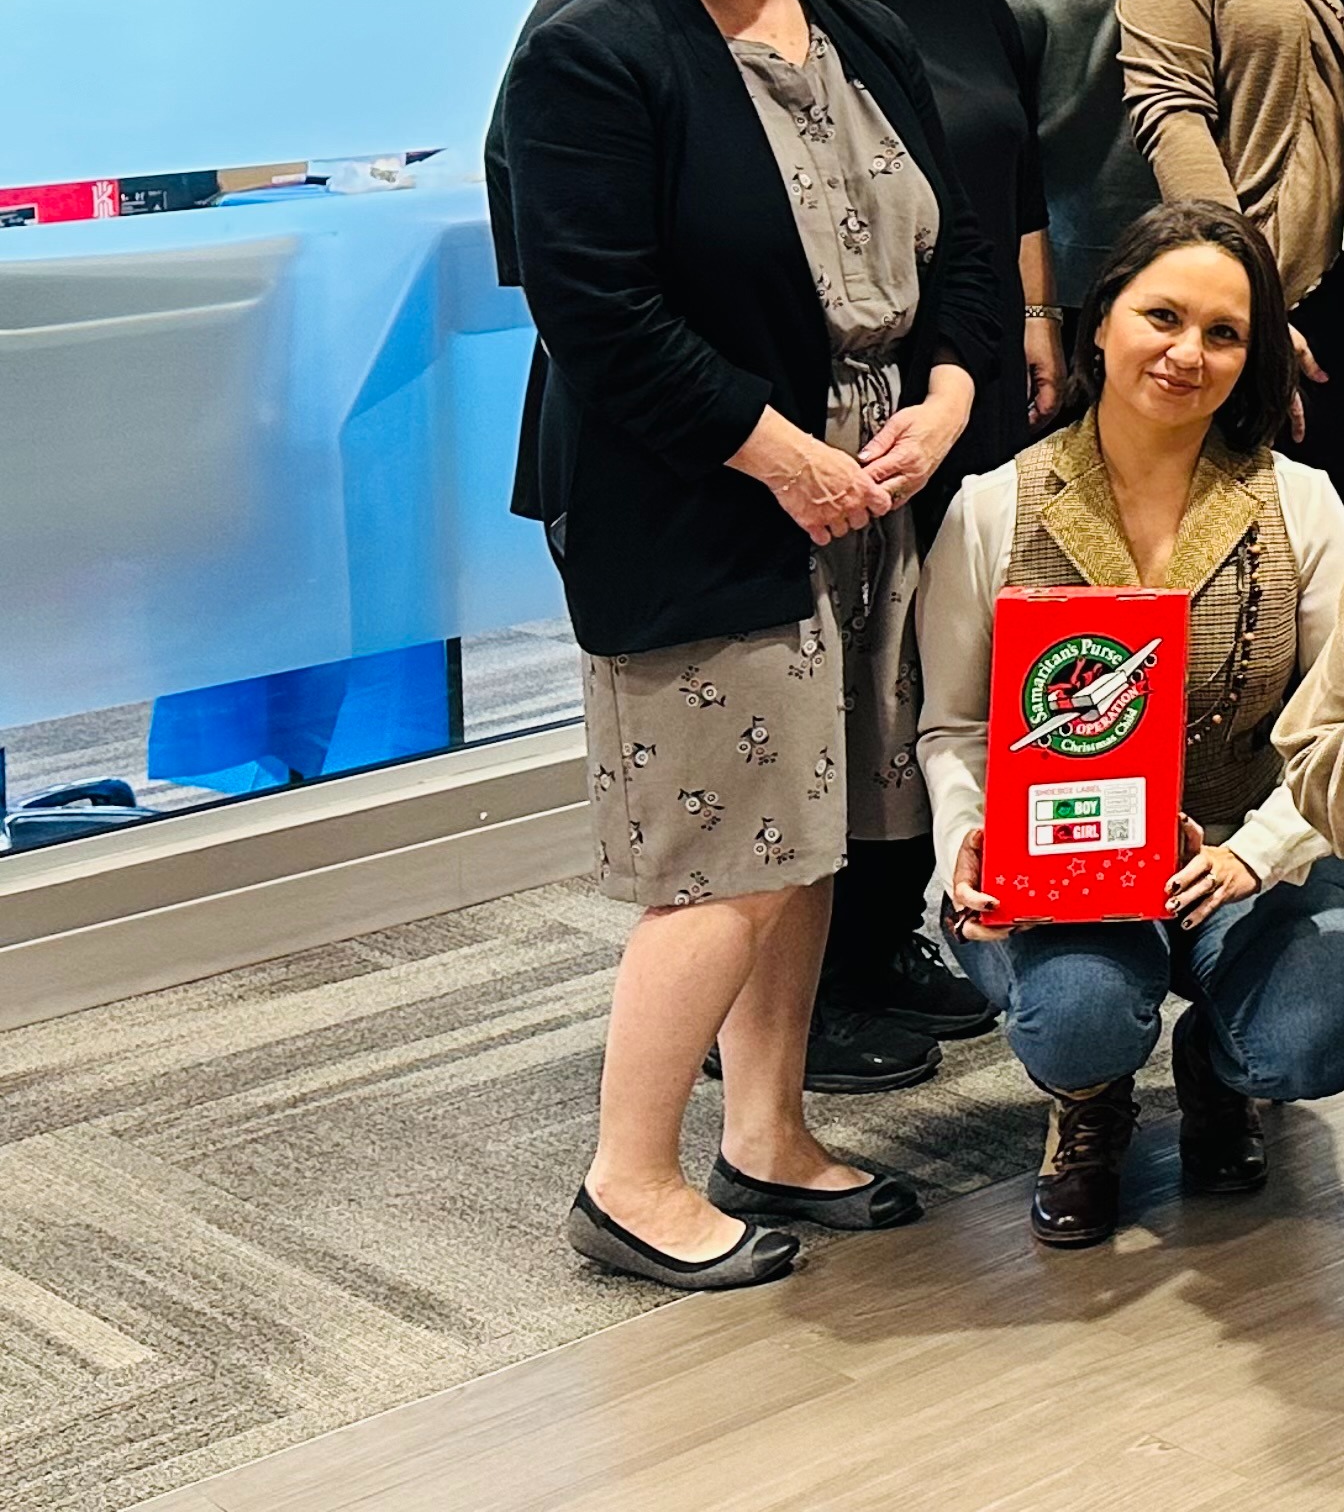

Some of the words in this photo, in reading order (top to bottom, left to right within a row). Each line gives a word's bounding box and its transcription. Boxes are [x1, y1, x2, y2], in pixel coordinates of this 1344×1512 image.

[1030, 643, 1079, 724] Samaritan's
[1080, 638, 1124, 665] Purse
[1060, 736, 1119, 753] Christmas
[1114, 706, 1138, 736] Child
[1075, 687, 1140, 735] OPERATION
[1074, 799, 1099, 815] BOY
[1072, 824, 1100, 840] GIRL
